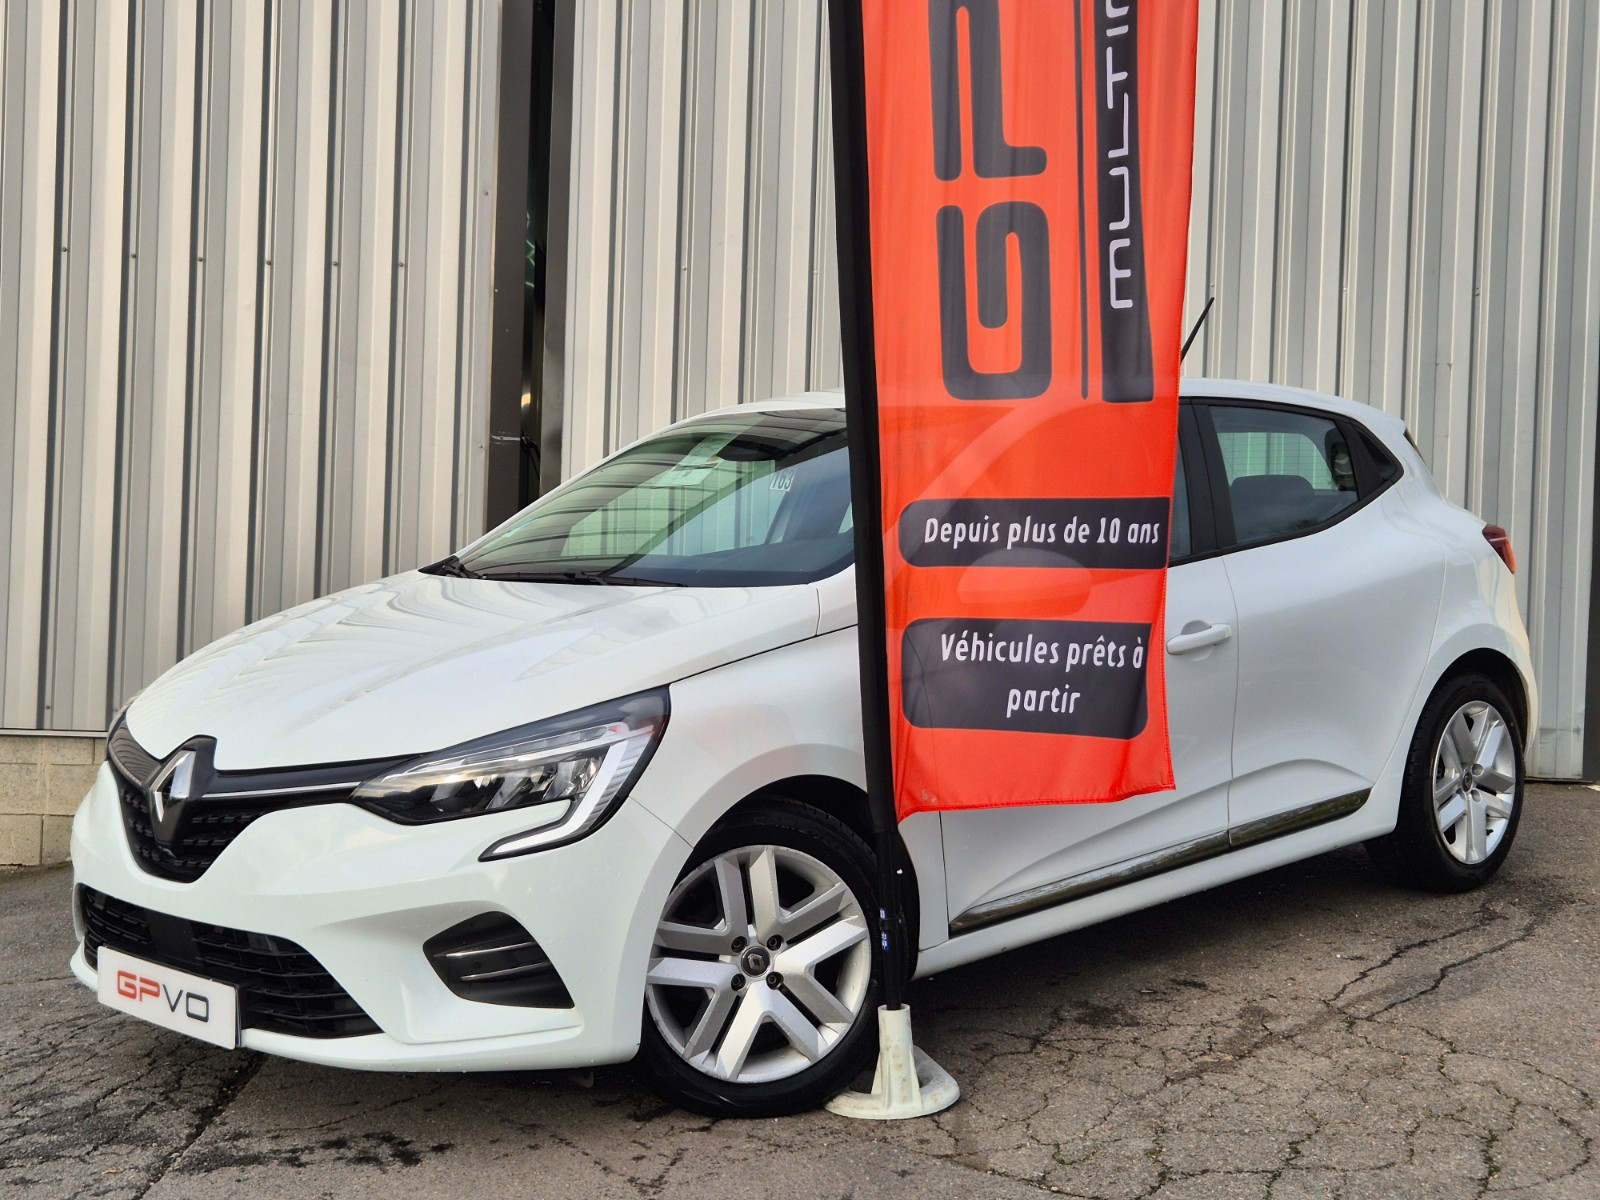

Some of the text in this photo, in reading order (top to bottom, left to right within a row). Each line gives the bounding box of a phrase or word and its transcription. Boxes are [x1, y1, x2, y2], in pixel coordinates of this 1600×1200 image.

[924, 516, 1160, 549] Depuis plus de 10 ans
[941, 629, 1145, 672] Véhicules prêts à
[1006, 684, 1081, 718] partir
[117, 970, 210, 1023] GPVO
